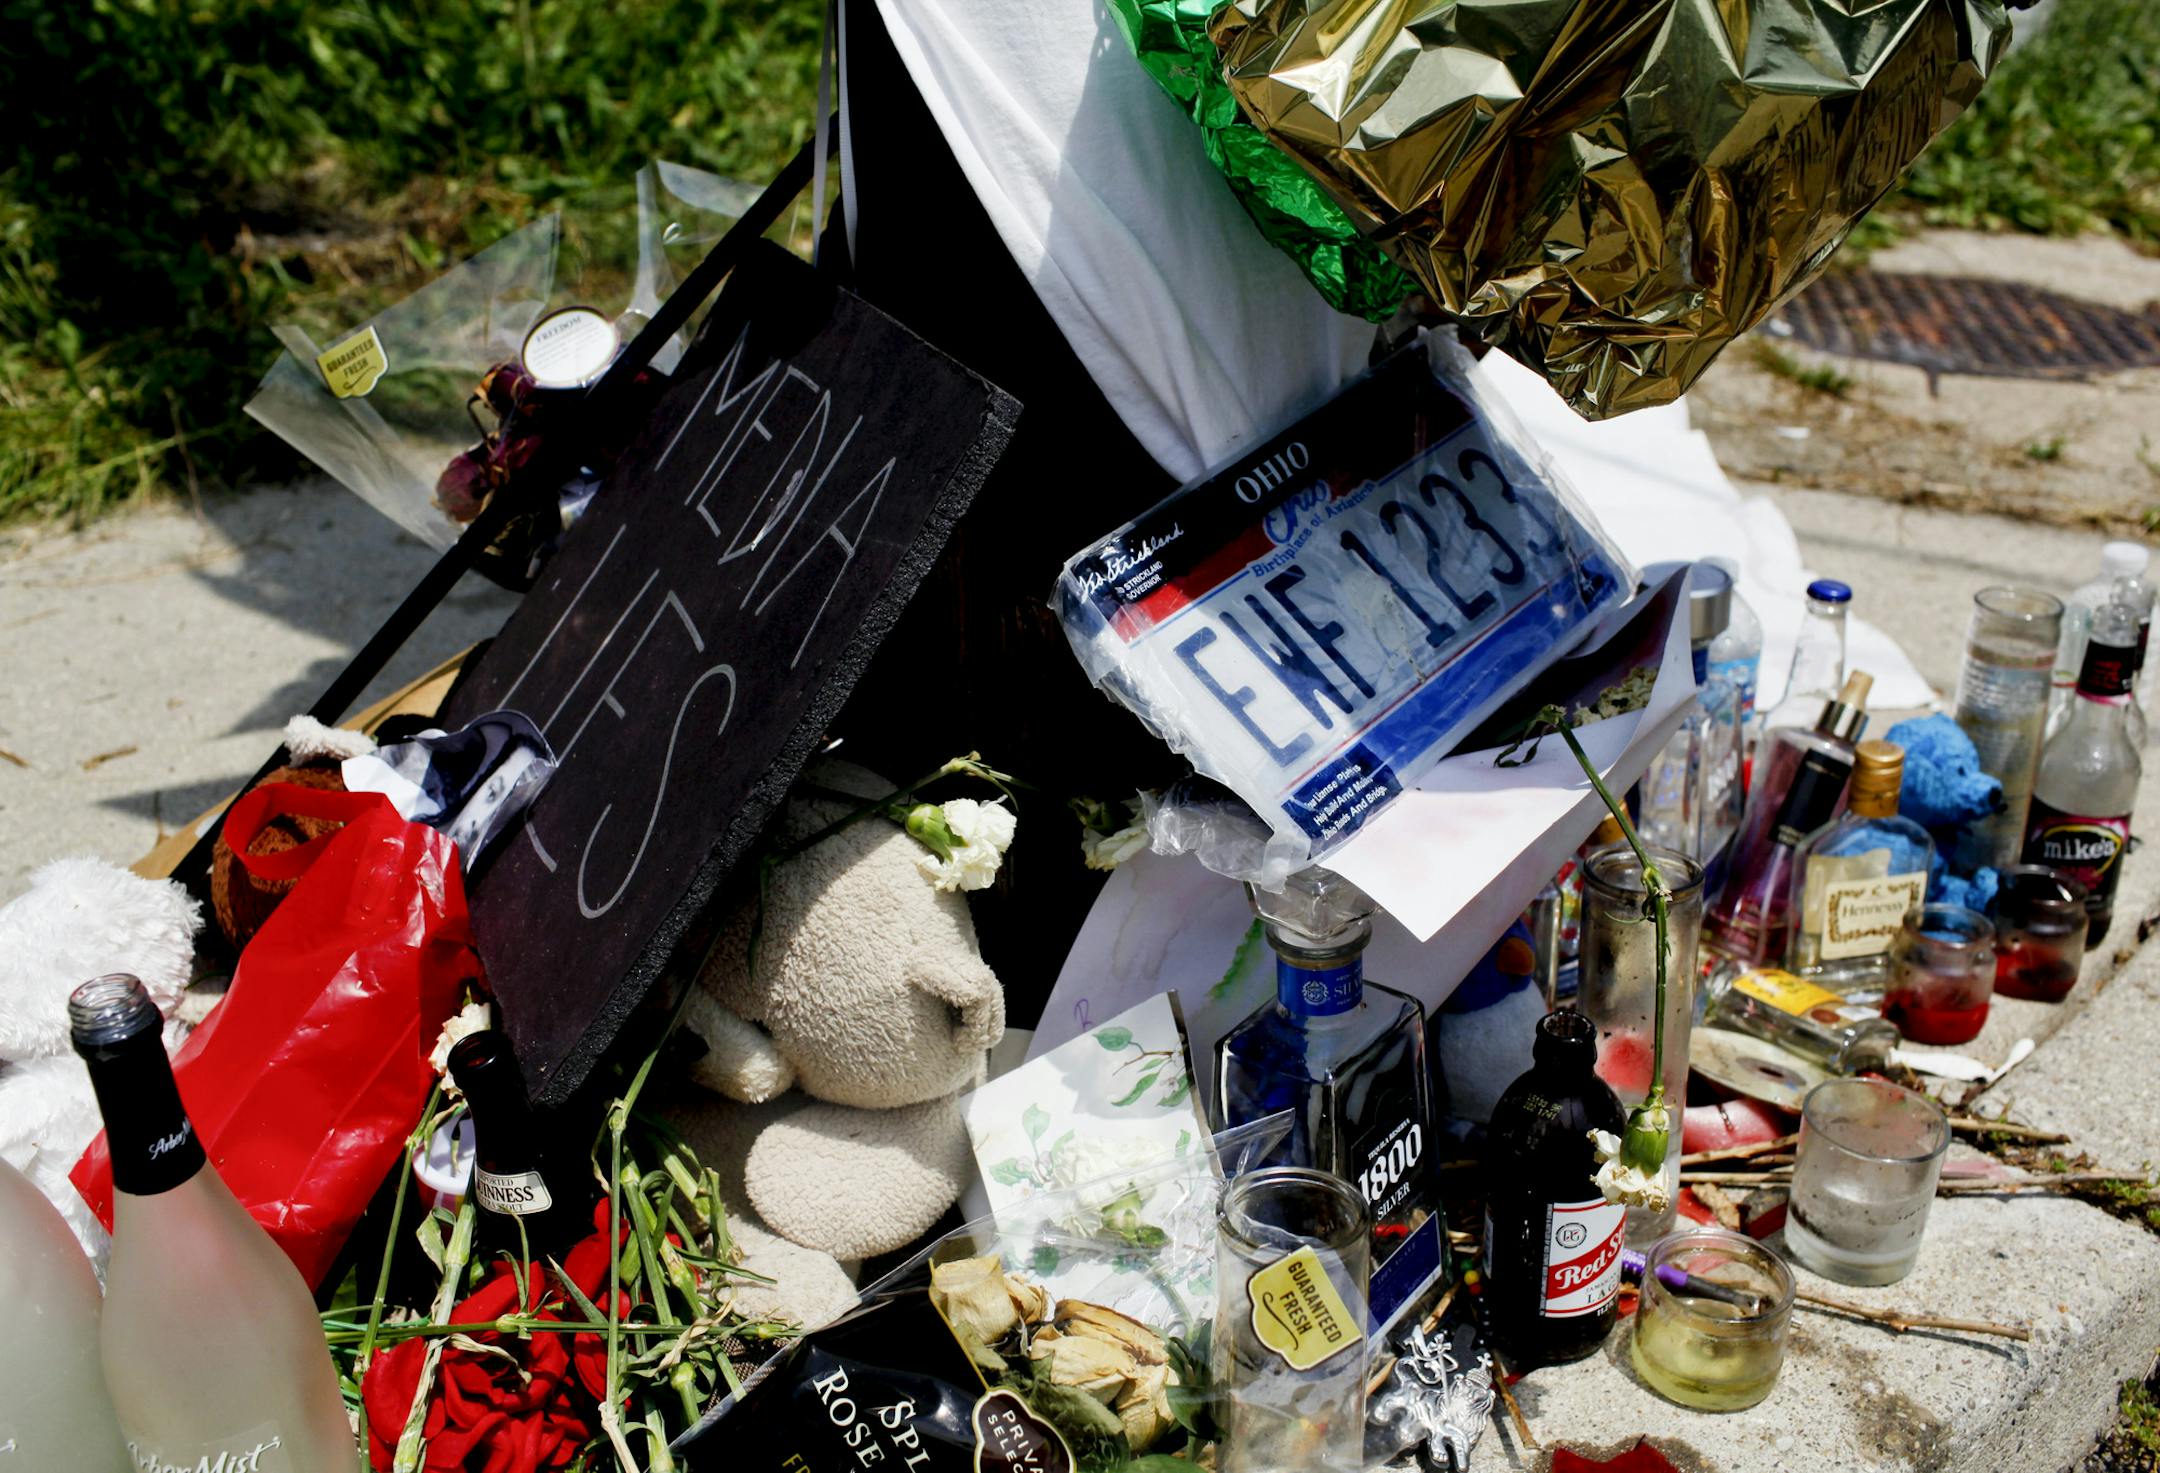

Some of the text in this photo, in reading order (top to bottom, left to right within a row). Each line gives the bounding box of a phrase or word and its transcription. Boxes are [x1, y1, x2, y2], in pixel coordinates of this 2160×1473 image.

[327, 338, 374, 373] GUARANTEED
[344, 358, 369, 377] FRESH
[654, 321, 896, 670] MEDIA
[1234, 442, 1309, 503] OHIO
[1106, 522, 1185, 583] Strickland
[1251, 480, 1376, 577] Birthplace of Aviation
[1123, 560, 1163, 591] STRICKLAND
[1173, 565, 1377, 768] EWF
[1336, 787, 1355, 806] And
[1350, 799, 1368, 817] And
[1358, 1124, 1422, 1206] 1800
[1377, 1182, 1410, 1220] SILVER
[1555, 1249, 1607, 1290] Red
[1280, 1290, 1313, 1336] FRESH
[1288, 1261, 1342, 1343] GUARANTEED
[812, 1365, 885, 1469] ROSE
